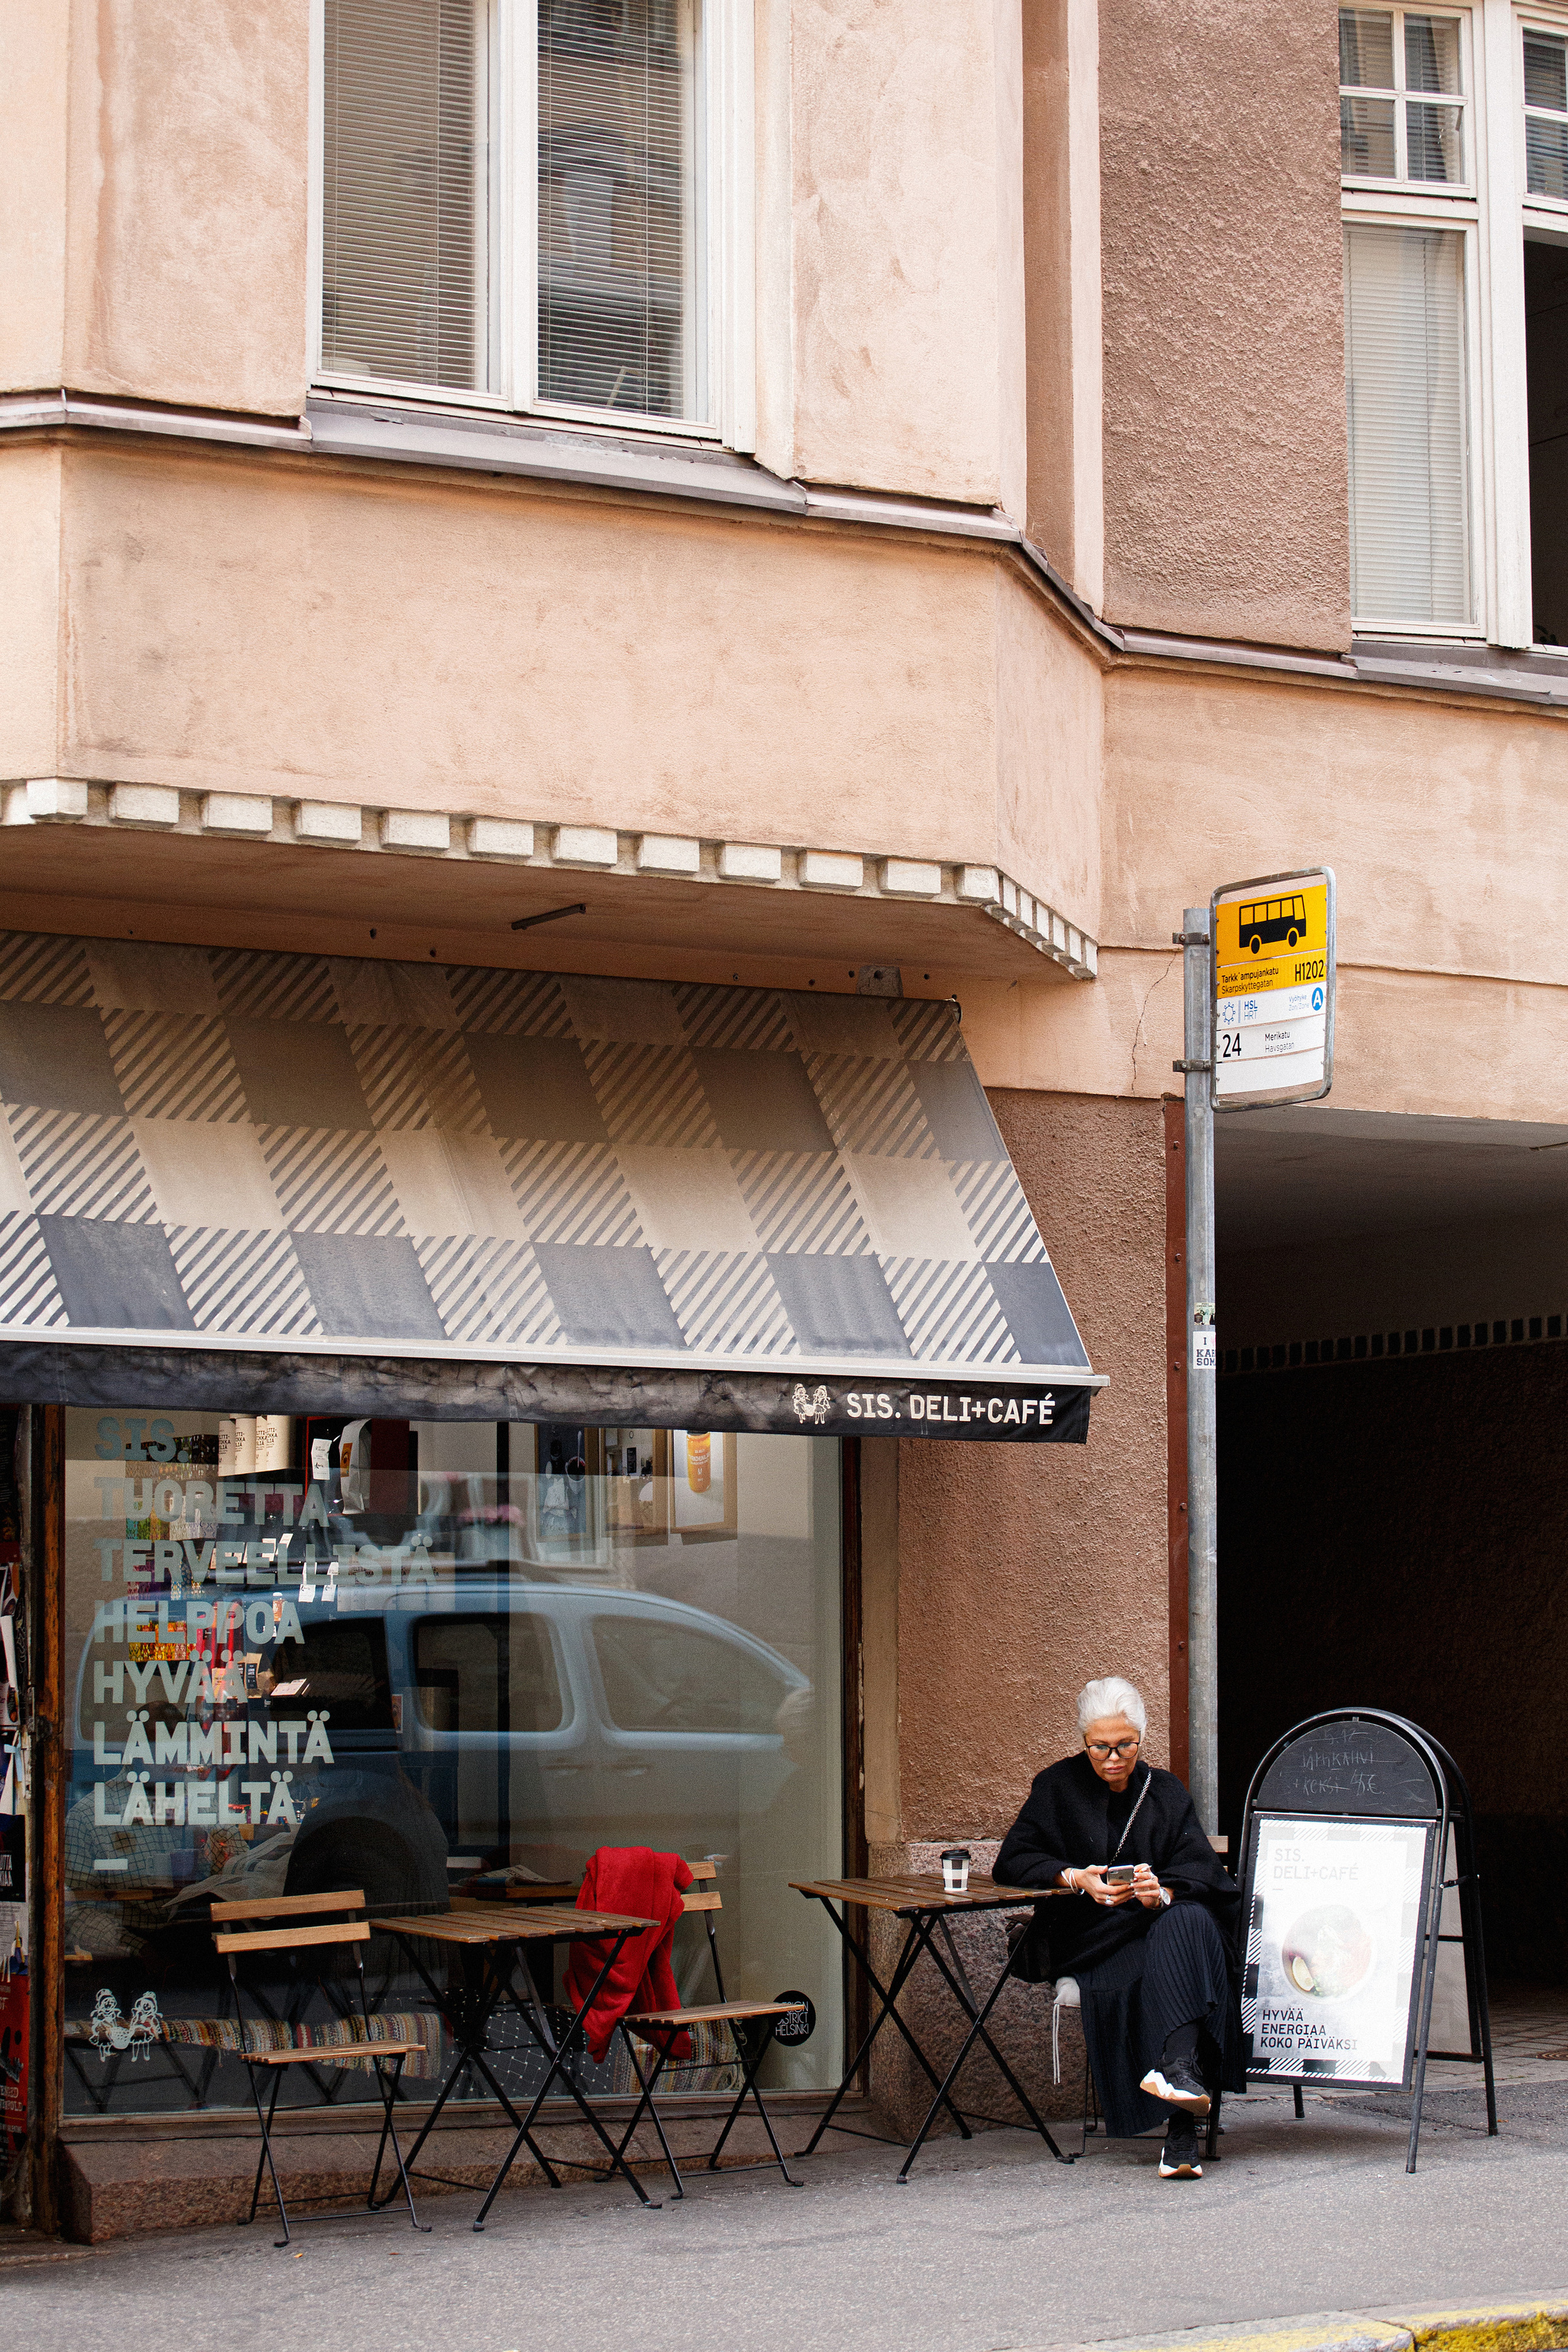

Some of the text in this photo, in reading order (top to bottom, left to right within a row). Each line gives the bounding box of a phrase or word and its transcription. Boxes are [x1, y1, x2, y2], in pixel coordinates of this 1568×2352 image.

[1295, 959, 1324, 981] H1202
[1221, 979, 1273, 994] Skarpskyttegatan
[1243, 1009, 1258, 1020] HRT
[1244, 1000, 1258, 1011] HSL
[1264, 1031, 1291, 1041] Merikatu
[1222, 1033, 1242, 1058] 24
[1264, 1042, 1295, 1053] Havsgatan
[846, 1392, 1056, 1425] SIS. DELI+CAFÉ
[95, 1416, 189, 1463] SIS.
[94, 1477, 330, 1527] TUORETTA
[92, 1535, 436, 1586] TERVEELLISTÄ
[94, 1600, 305, 1645] HELPPOA
[94, 1649, 248, 1704] HYVÄÄ
[94, 1709, 334, 1765] LÄMMINTÄ
[94, 1770, 299, 1826] LÄHELTÄ
[1274, 1848, 1305, 1862] SIS.
[1273, 1862, 1359, 1880] DELI+CAFÉ
[1262, 2008, 1303, 2021] HYVÄÄ
[775, 2023, 809, 2036] HELSINKI
[1262, 2023, 1326, 2035] ENERGIAA
[1261, 2035, 1358, 2050] KOKO PÄIVÄKSI
